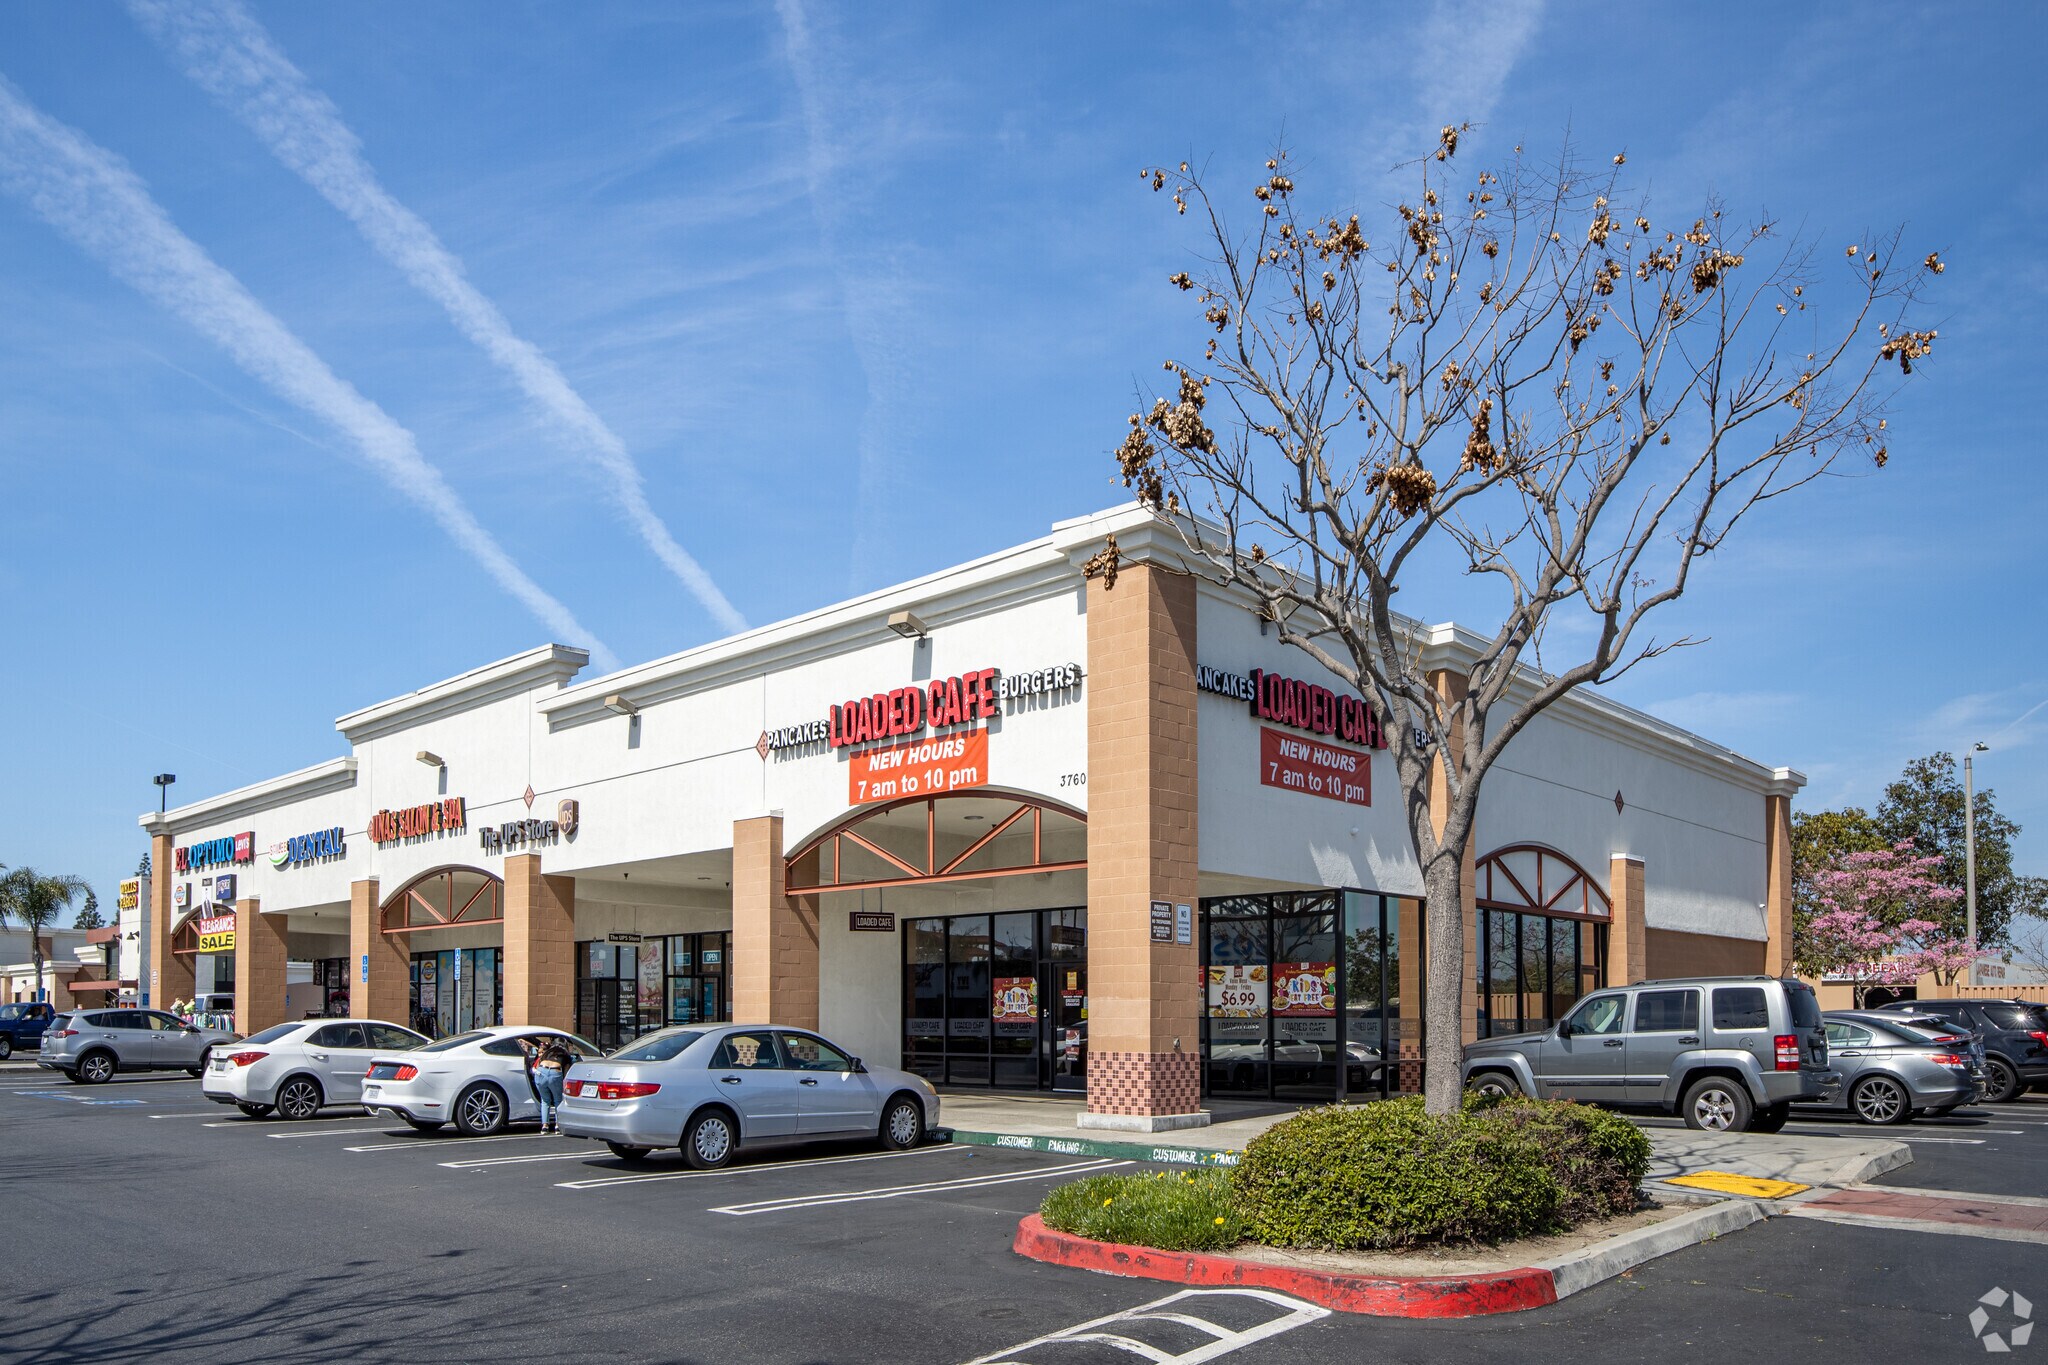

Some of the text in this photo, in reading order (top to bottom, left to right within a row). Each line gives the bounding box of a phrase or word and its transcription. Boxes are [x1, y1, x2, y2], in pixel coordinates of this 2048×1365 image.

[1000, 662, 1080, 700] BURGERS
[1197, 664, 1255, 700] ANCAKES
[829, 667, 998, 749] LOADED CAFE
[1251, 667, 1336, 736] LOADED
[767, 718, 828, 750] PANCAKES
[868, 738, 966, 772] NEW HOURS
[1279, 738, 1356, 773] NEW HOURS
[858, 764, 978, 801] 7 am to 10 pm
[1059, 772, 1087, 789] 3760
[1269, 761, 1365, 802] 7 am to 10 pm
[372, 797, 463, 843] UÑAS SALON & SPA
[560, 809, 573, 829] ups
[479, 818, 555, 848] The UPS Store
[175, 836, 235, 871] EL OPTIMO
[235, 837, 250, 852] Levi's
[288, 826, 343, 863] DENTAL
[201, 916, 235, 934] CLEARANCE
[857, 917, 892, 927] LOADED CAFE
[201, 934, 234, 949] SALE
[706, 953, 718, 962] OPEN
[1221, 990, 1256, 1007] $6.99
[1289, 993, 1319, 1002] EAT FREE
[1015, 1003, 1027, 1011] FREE
[928, 1021, 940, 1029] CAFE
[954, 1021, 985, 1030] LOADED CAFE
[1000, 1021, 1032, 1030] LOADED CAFE
[1282, 1022, 1327, 1032] LOADED CAFE
[996, 1135, 1079, 1153] CUSTOMER PARKING
[1152, 1148, 1197, 1164] CUSTOMER
